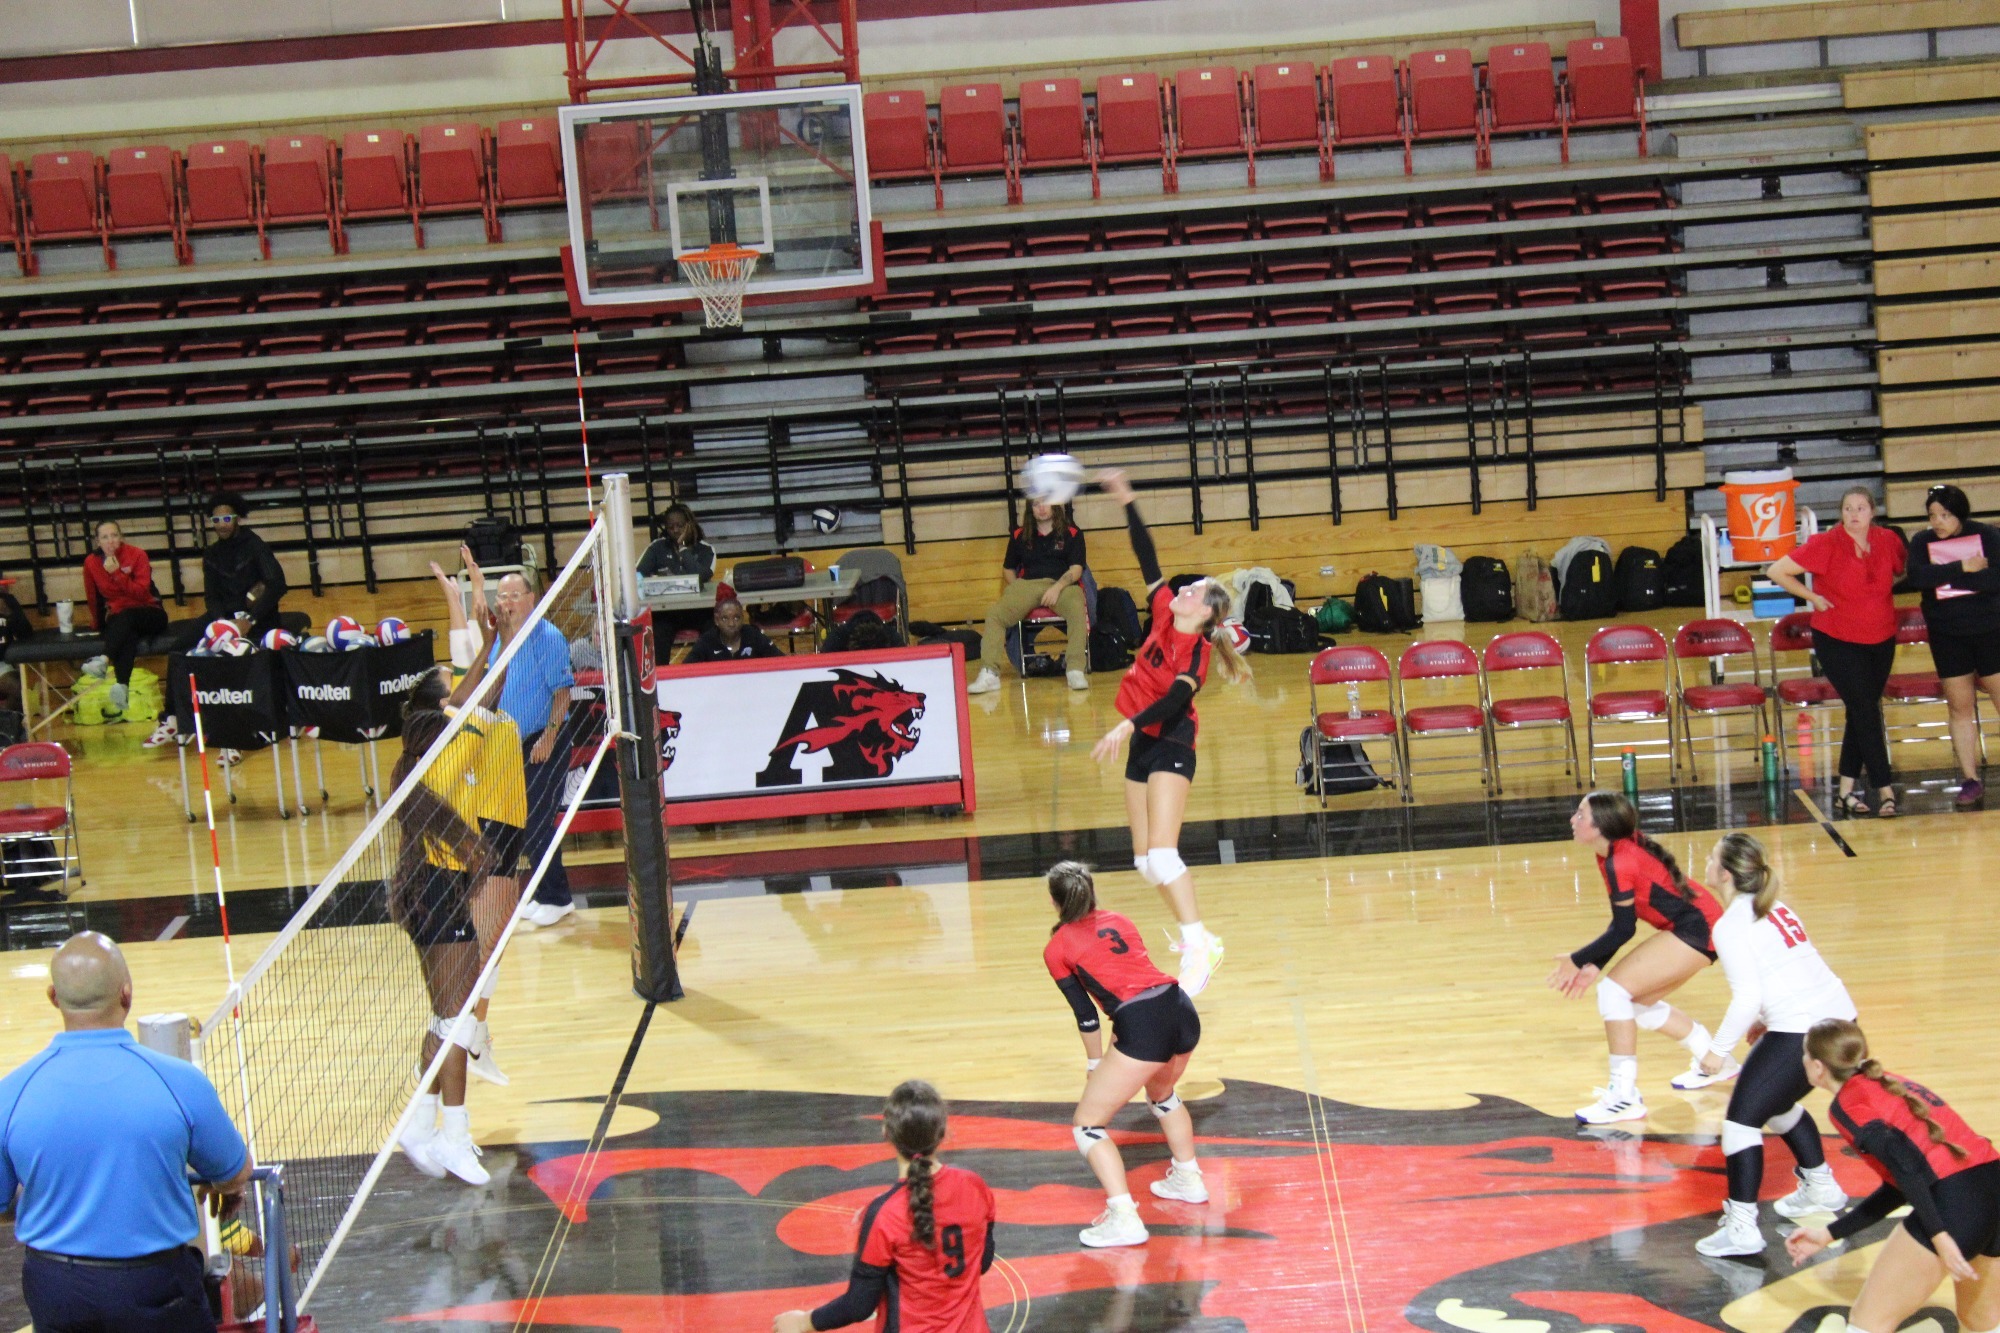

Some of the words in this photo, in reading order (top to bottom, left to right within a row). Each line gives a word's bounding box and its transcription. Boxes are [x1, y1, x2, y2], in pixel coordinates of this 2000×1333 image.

[1755, 496, 1776, 520] G
[298, 684, 350, 701] molten
[1097, 927, 1129, 955] 3
[1767, 907, 1807, 949] 15
[942, 1224, 965, 1278] 9
